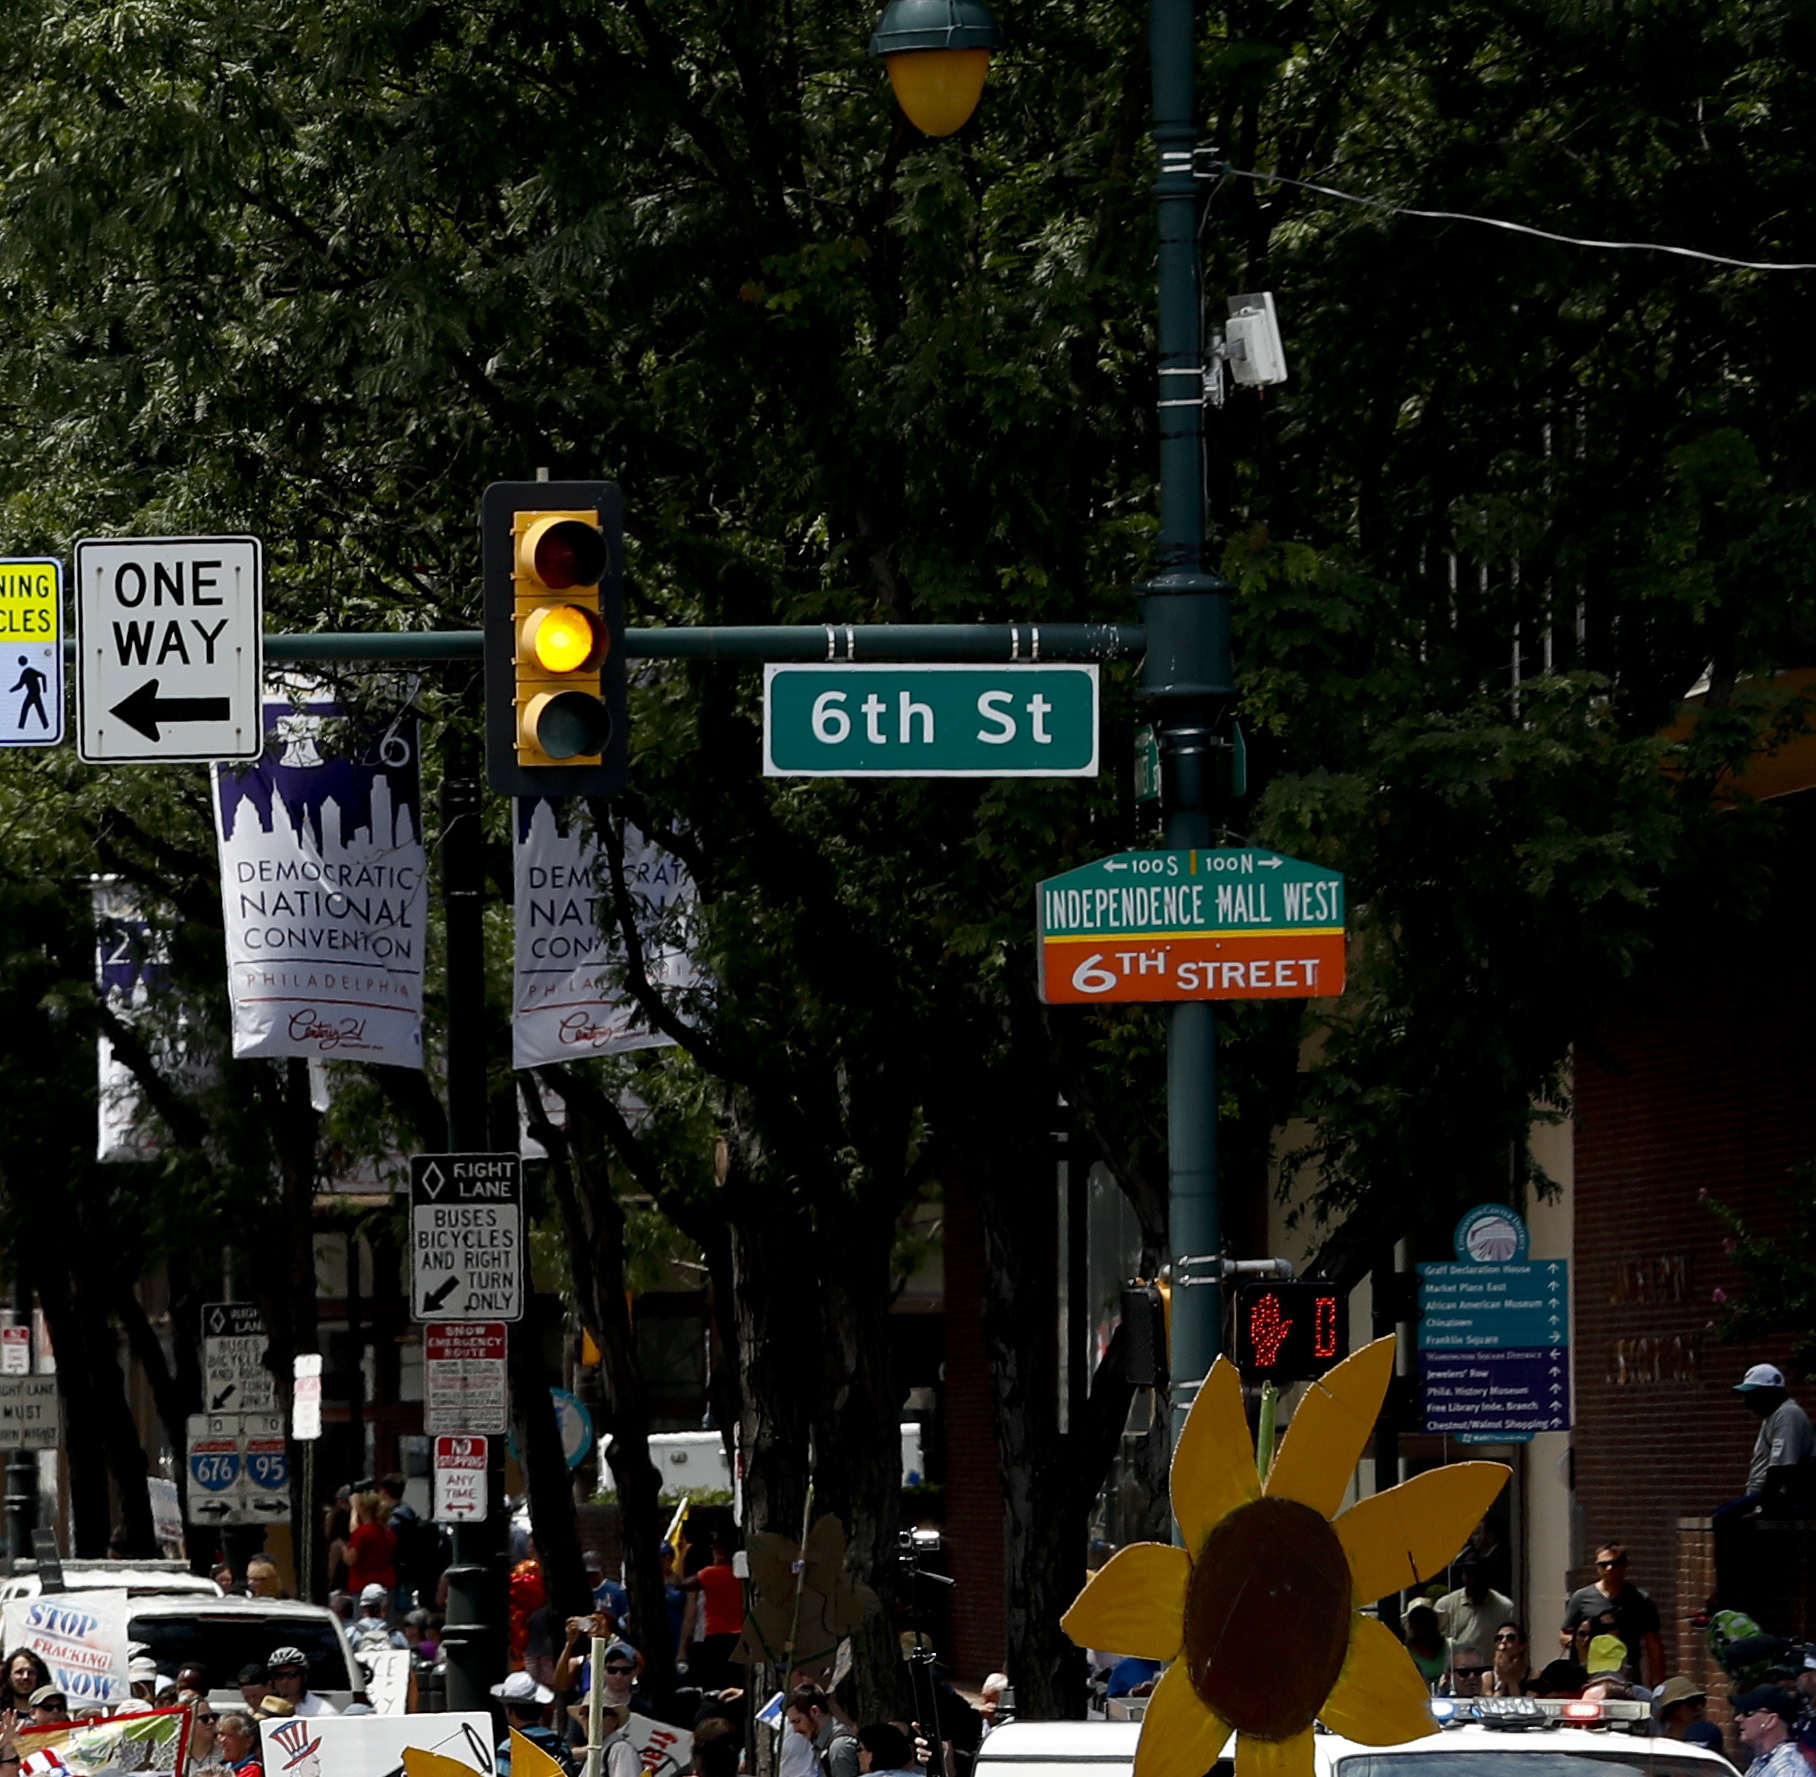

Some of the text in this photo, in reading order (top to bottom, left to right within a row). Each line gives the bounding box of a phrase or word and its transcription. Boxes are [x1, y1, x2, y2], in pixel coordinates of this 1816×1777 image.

[115, 561, 223, 608] ONE
[112, 618, 229, 666] WAY
[812, 688, 1053, 747] 6th St
[1045, 881, 1339, 929] INDEPENDENCE MALL WEST
[1177, 959, 1320, 990] STREET
[454, 1163, 515, 1178] RIGHT
[459, 1182, 511, 1197] LANE
[435, 1210, 496, 1228] BUSES
[419, 1230, 514, 1248] BICYCLES
[421, 1252, 511, 1270] AND RIGHT
[469, 1272, 514, 1289] TURN
[469, 1293, 514, 1311] ONLY
[1425, 1299, 1542, 1310] African American Museum
[445, 1326, 485, 1336] SNOW
[1426, 1318, 1472, 1327] Chinatown
[429, 1338, 502, 1346] EMERGENCY
[1426, 1335, 1499, 1345] Franklin Square
[447, 1475, 475, 1485] ANY
[446, 1488, 476, 1499] TIME
